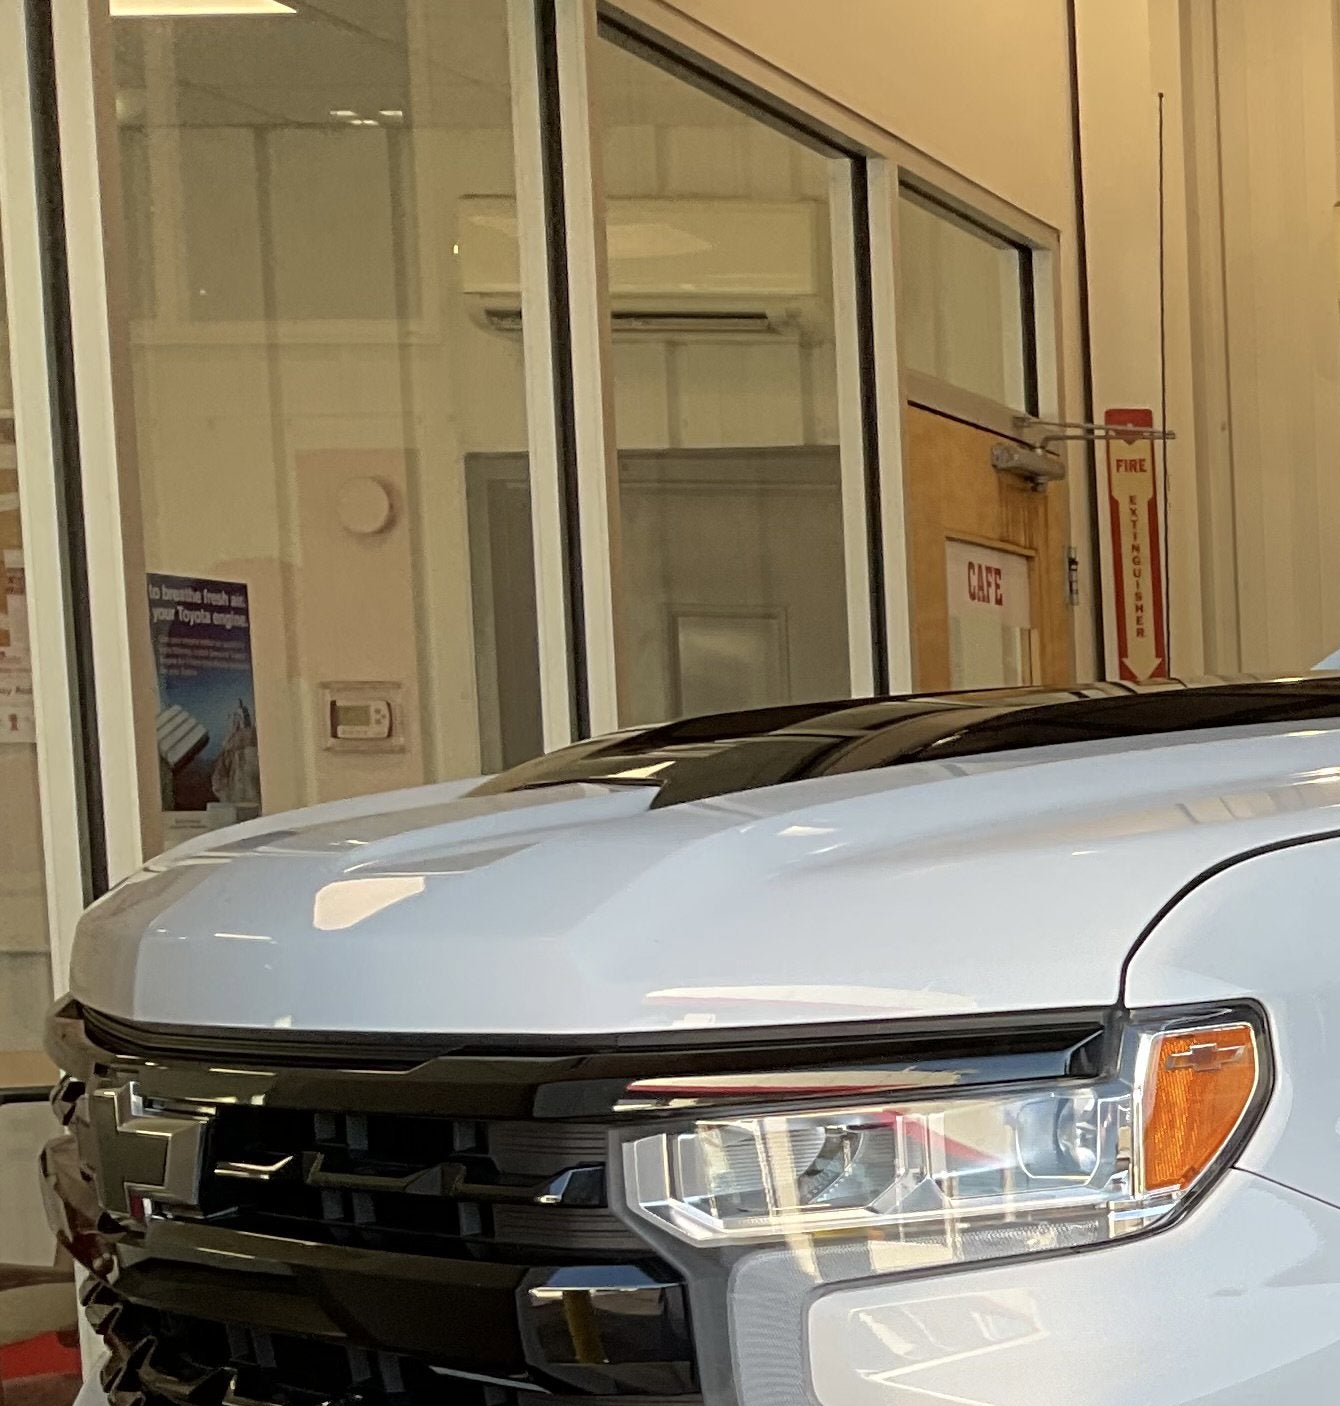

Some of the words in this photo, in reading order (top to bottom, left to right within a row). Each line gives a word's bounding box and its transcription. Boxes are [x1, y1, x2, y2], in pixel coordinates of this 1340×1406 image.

[1115, 458, 1148, 473] FIRE
[1128, 495, 1145, 638] EXTINGUISHER
[967, 560, 1003, 607] CAFE
[149, 584, 161, 600] to
[162, 584, 202, 604] breathe
[203, 588, 229, 606] fresh
[152, 607, 175, 623] your
[176, 606, 211, 626] Toyota
